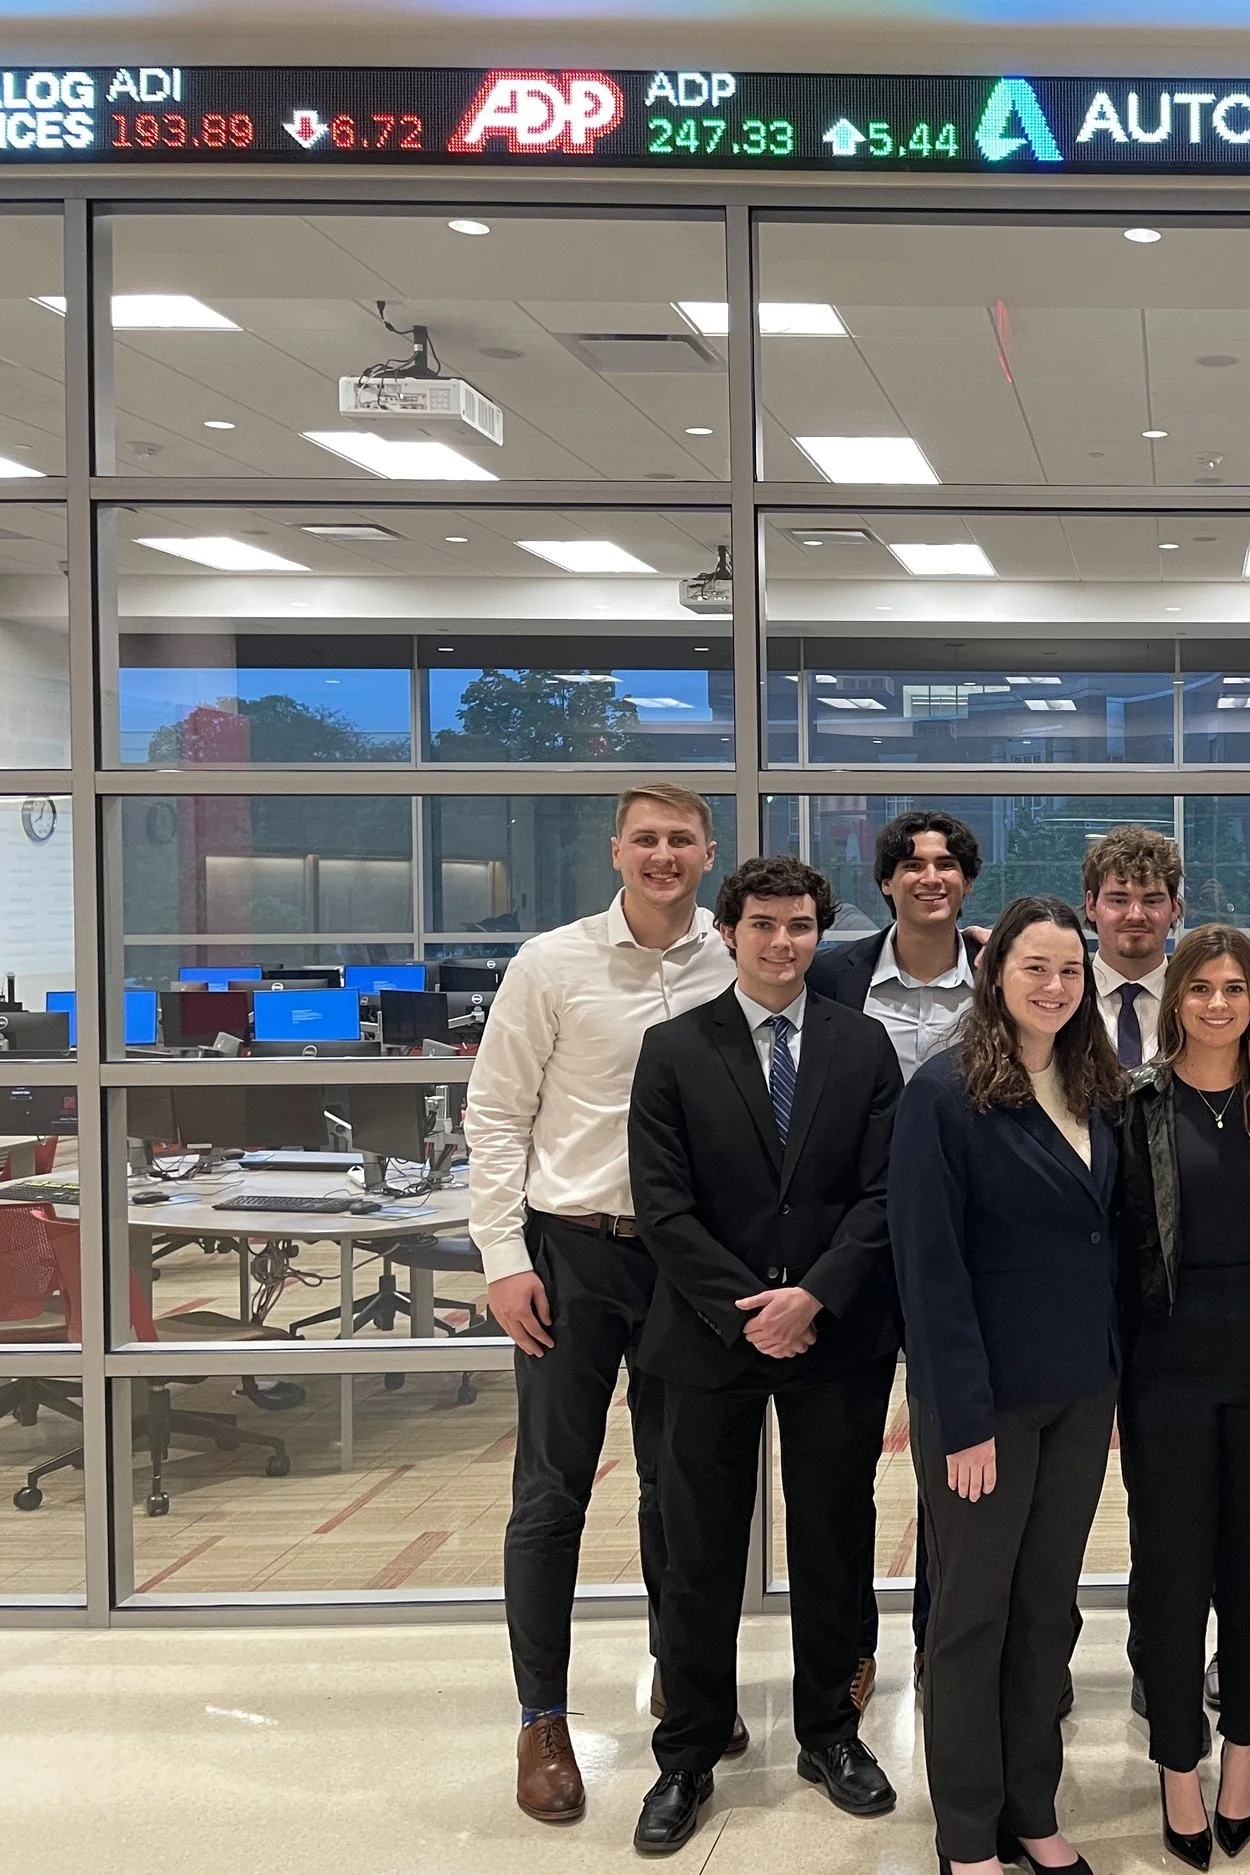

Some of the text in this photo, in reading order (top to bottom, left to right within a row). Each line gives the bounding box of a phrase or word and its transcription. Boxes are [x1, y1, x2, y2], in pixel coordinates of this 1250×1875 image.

[3, 72, 95, 108] LOG
[106, 68, 182, 102] ADI
[644, 72, 736, 107] ADP
[448, 70, 625, 154] ADP
[112, 113, 422, 149] 193.89 6.72
[648, 118, 958, 157] 247.33 5.44
